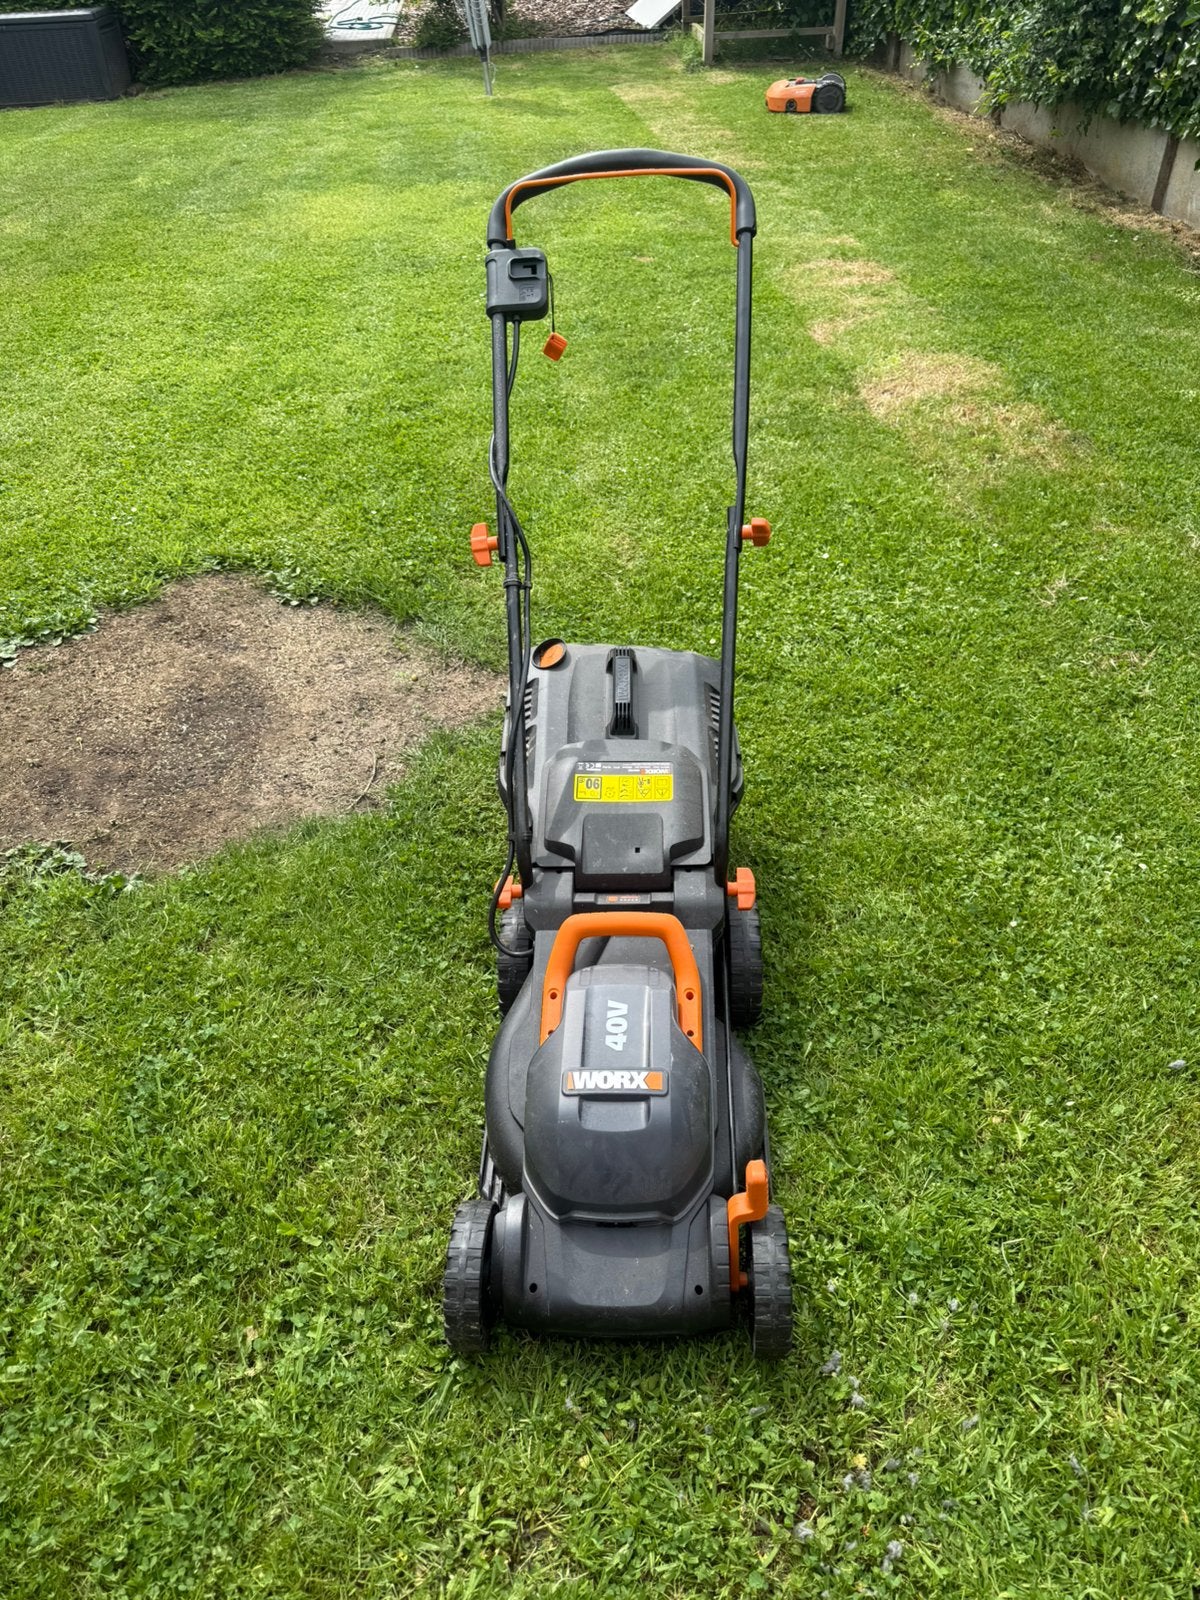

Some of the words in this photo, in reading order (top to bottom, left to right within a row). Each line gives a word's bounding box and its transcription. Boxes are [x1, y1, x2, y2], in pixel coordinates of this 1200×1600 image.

[586, 779, 600, 789] 90
[605, 999, 629, 1051] 40V
[572, 1071, 649, 1090] WORX
